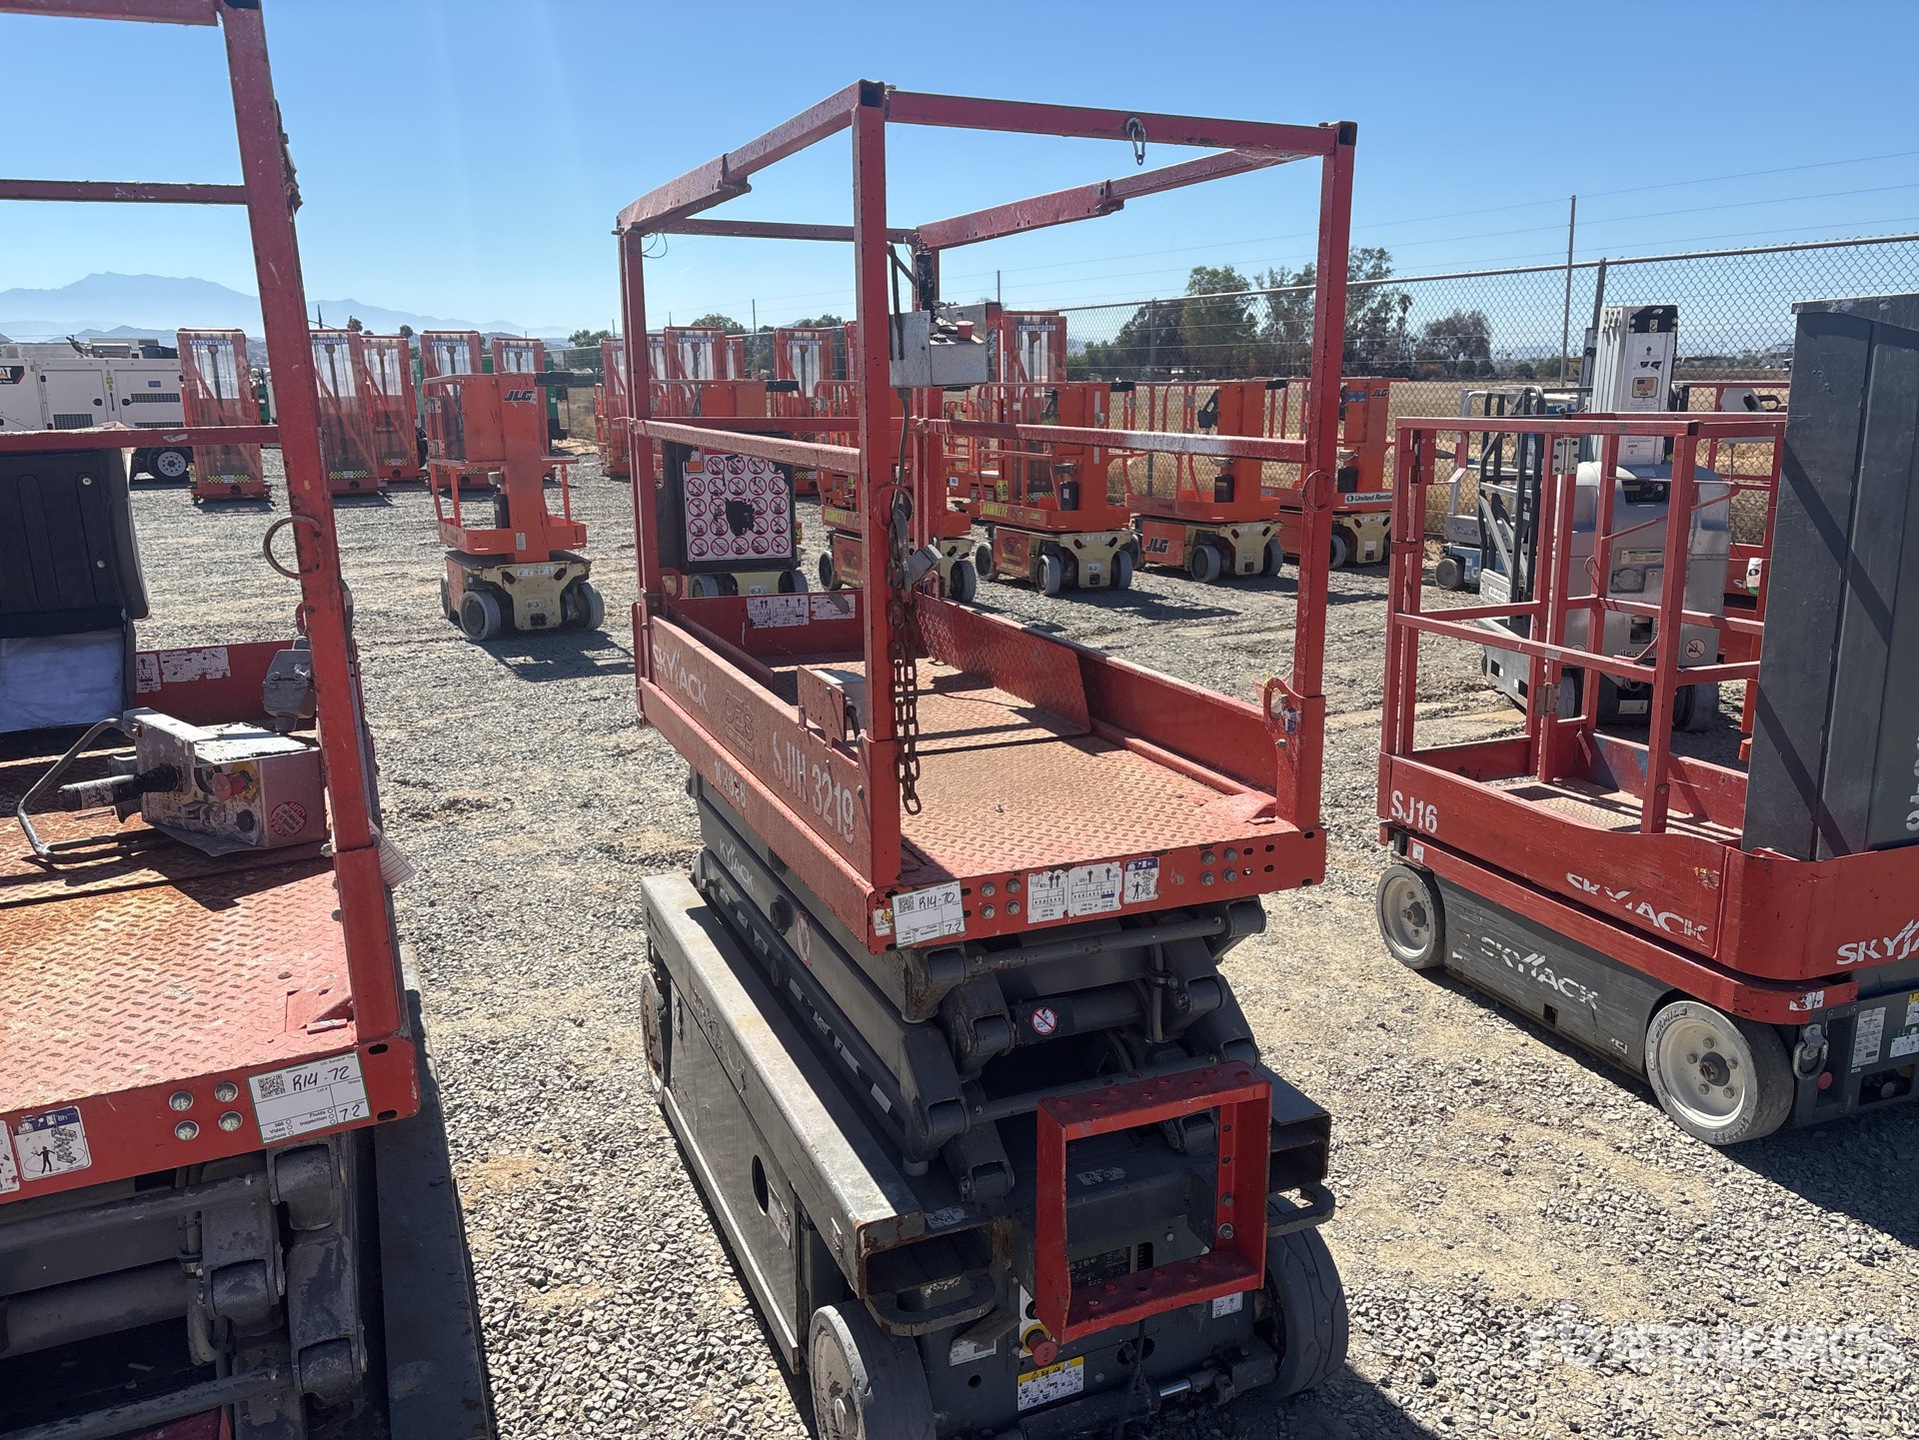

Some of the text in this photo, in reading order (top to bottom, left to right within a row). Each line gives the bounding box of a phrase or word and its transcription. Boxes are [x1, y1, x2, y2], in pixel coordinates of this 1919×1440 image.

[504, 390, 535, 402] JLG
[1371, 389, 1389, 398] JLG
[1354, 494, 1375, 502] United
[1145, 538, 1169, 553] JLG
[811, 763, 855, 845] 3219
[1391, 789, 1438, 834] SJ16
